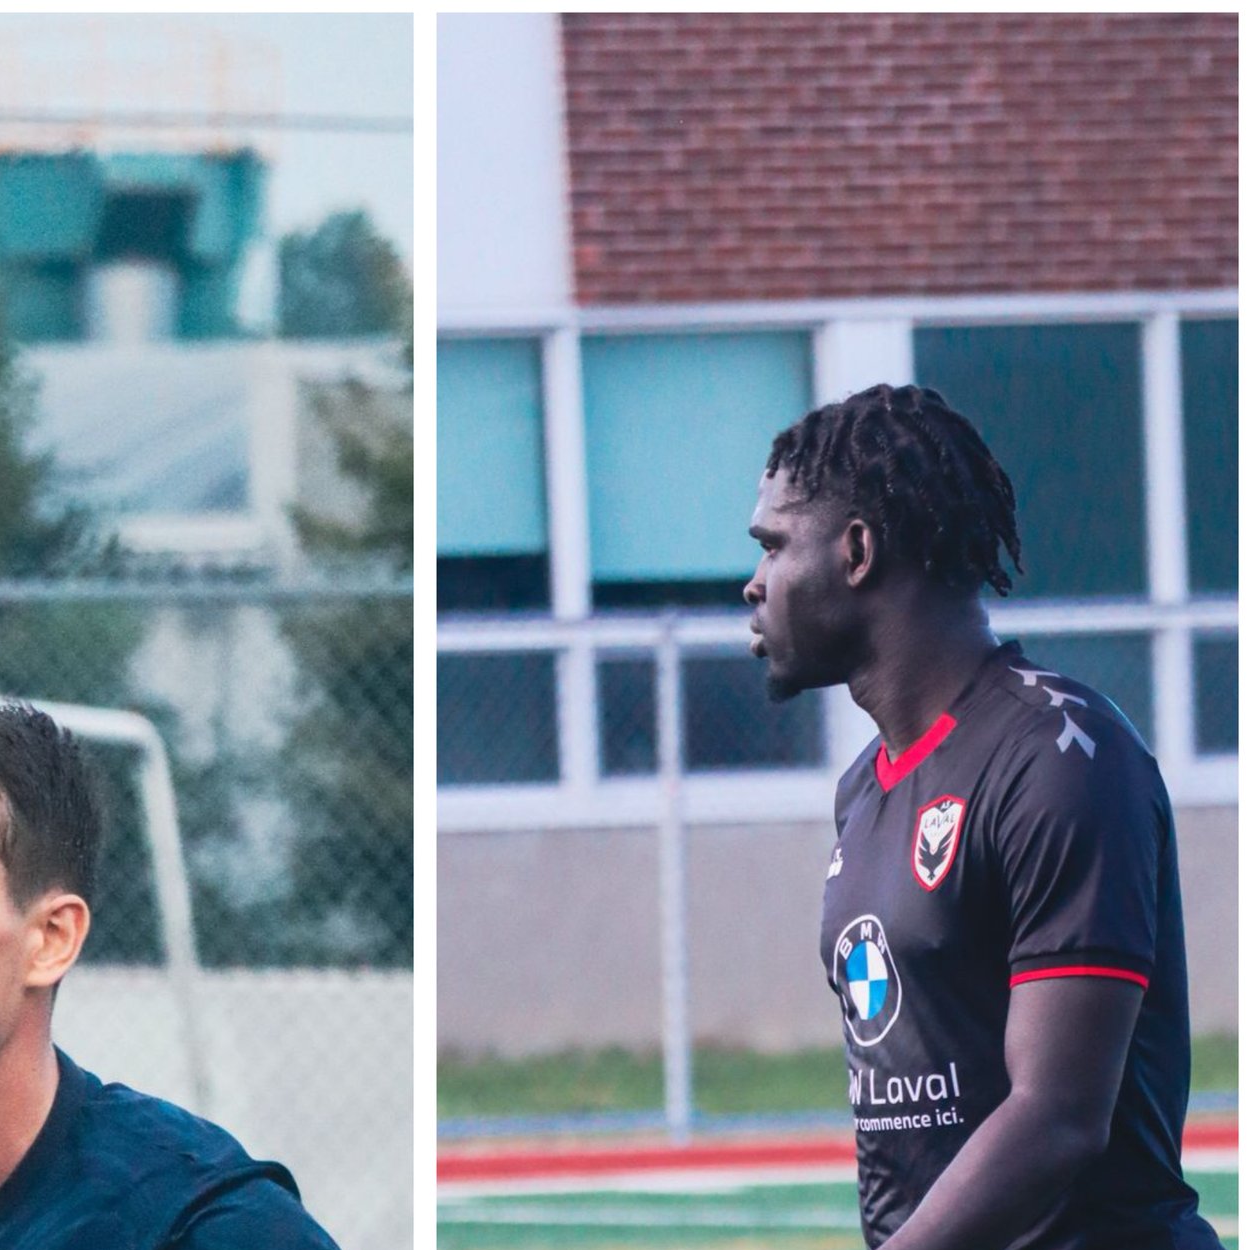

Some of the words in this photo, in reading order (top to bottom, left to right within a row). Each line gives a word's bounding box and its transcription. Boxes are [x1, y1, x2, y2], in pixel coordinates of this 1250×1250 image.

[870, 1062, 960, 1105] Laval
[860, 1114, 932, 1132] commence
[936, 1106, 964, 1126] ici.
